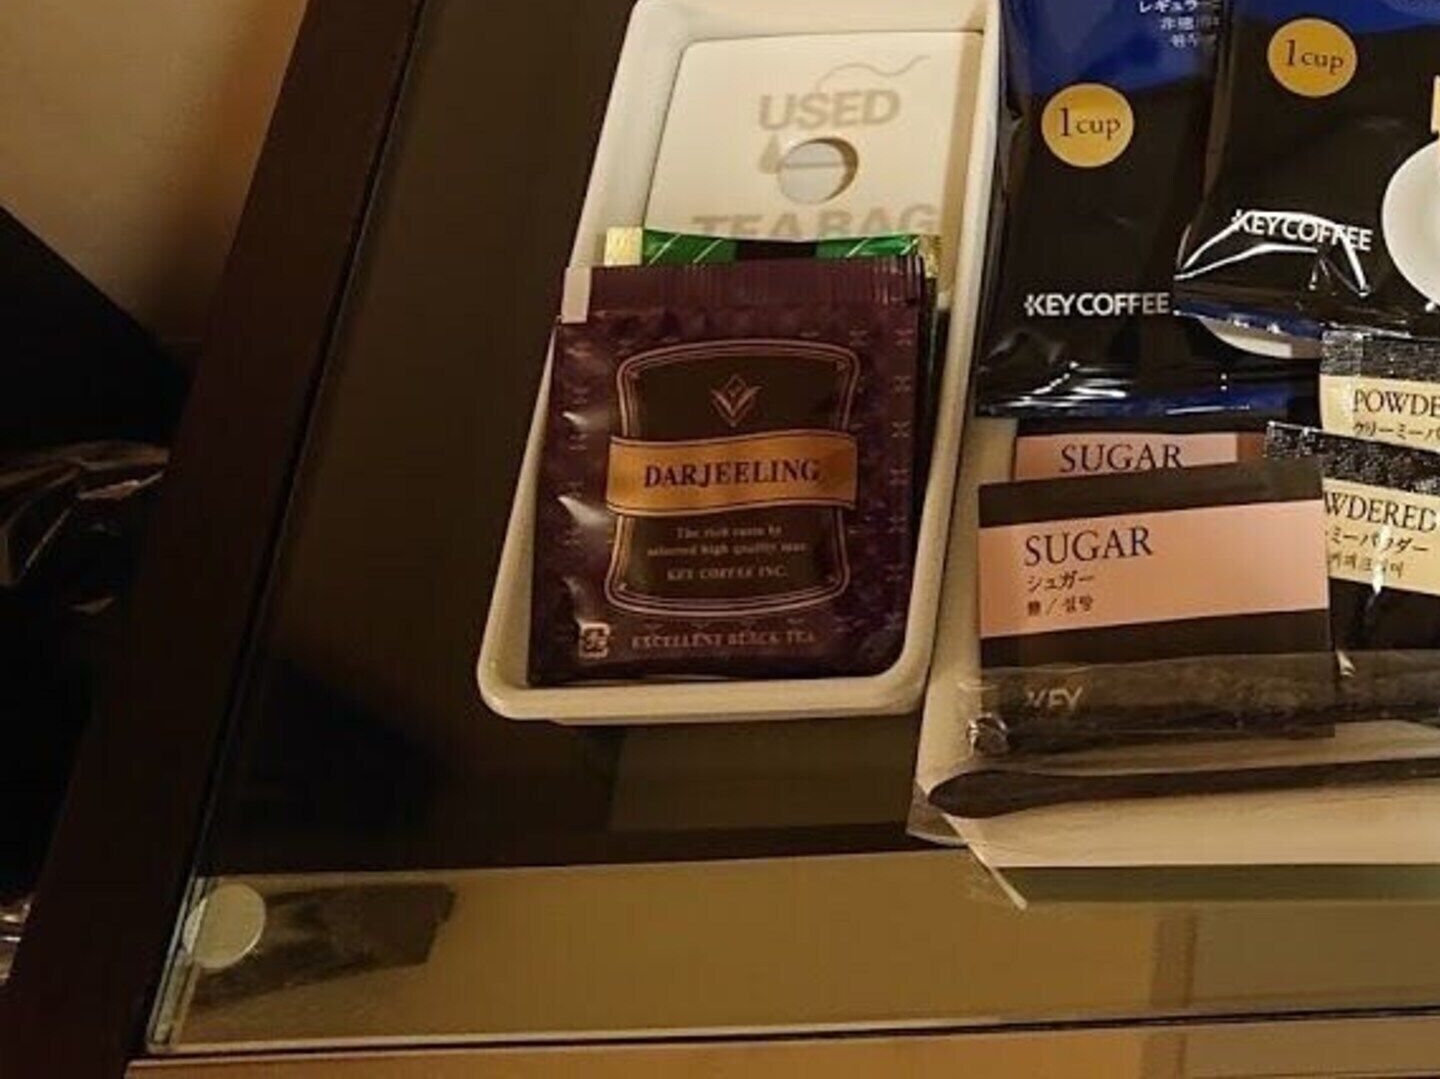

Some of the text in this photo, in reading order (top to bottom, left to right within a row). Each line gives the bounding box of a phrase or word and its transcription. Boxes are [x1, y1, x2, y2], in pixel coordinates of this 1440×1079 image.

[757, 88, 902, 132] USED
[1060, 442, 1185, 473] SUGAR
[644, 458, 821, 489] DARJEELING
[1323, 491, 1438, 533] WDERED
[1023, 525, 1154, 568] SUGAR
[1027, 569, 1095, 593] シュガー
[631, 631, 723, 650] EXCELLENT
[727, 630, 780, 646] BLACK
